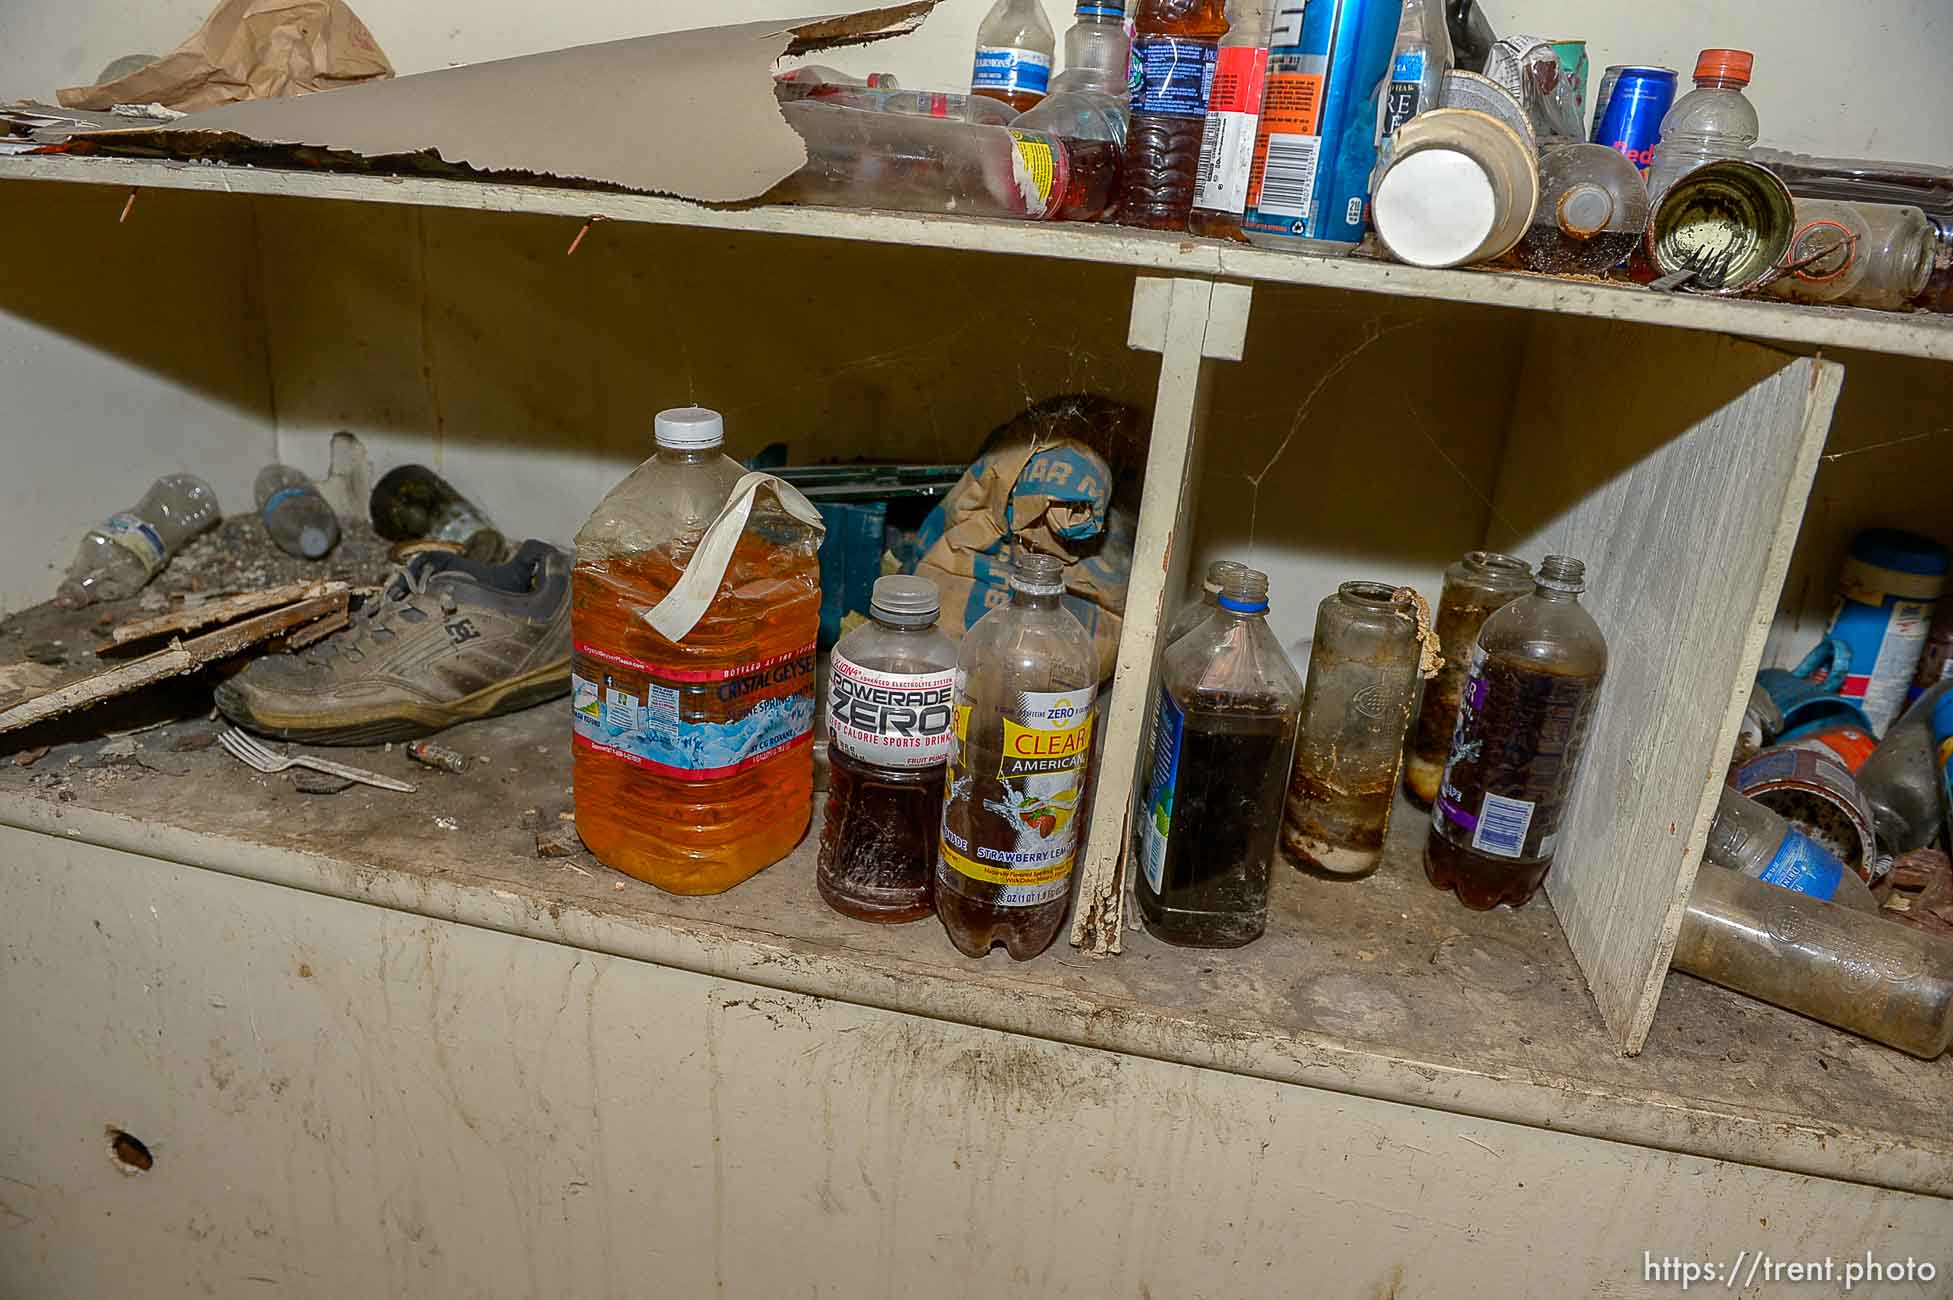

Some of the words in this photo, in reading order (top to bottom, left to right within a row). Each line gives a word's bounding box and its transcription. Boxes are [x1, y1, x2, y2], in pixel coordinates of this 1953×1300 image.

[773, 655, 816, 686] GEYSE
[833, 672, 951, 706] POWERADE
[832, 686, 951, 738] ZERO
[1047, 706, 1074, 720] ZERO
[843, 727, 879, 745] CALORIE
[882, 736, 921, 748] SPORTS
[1015, 727, 1086, 755] CLEAR
[906, 756, 927, 765] FRUIT
[928, 753, 948, 763] PUNC
[1011, 754, 1085, 773] AMERICAN
[977, 847, 1048, 863] STRAWBERRY
